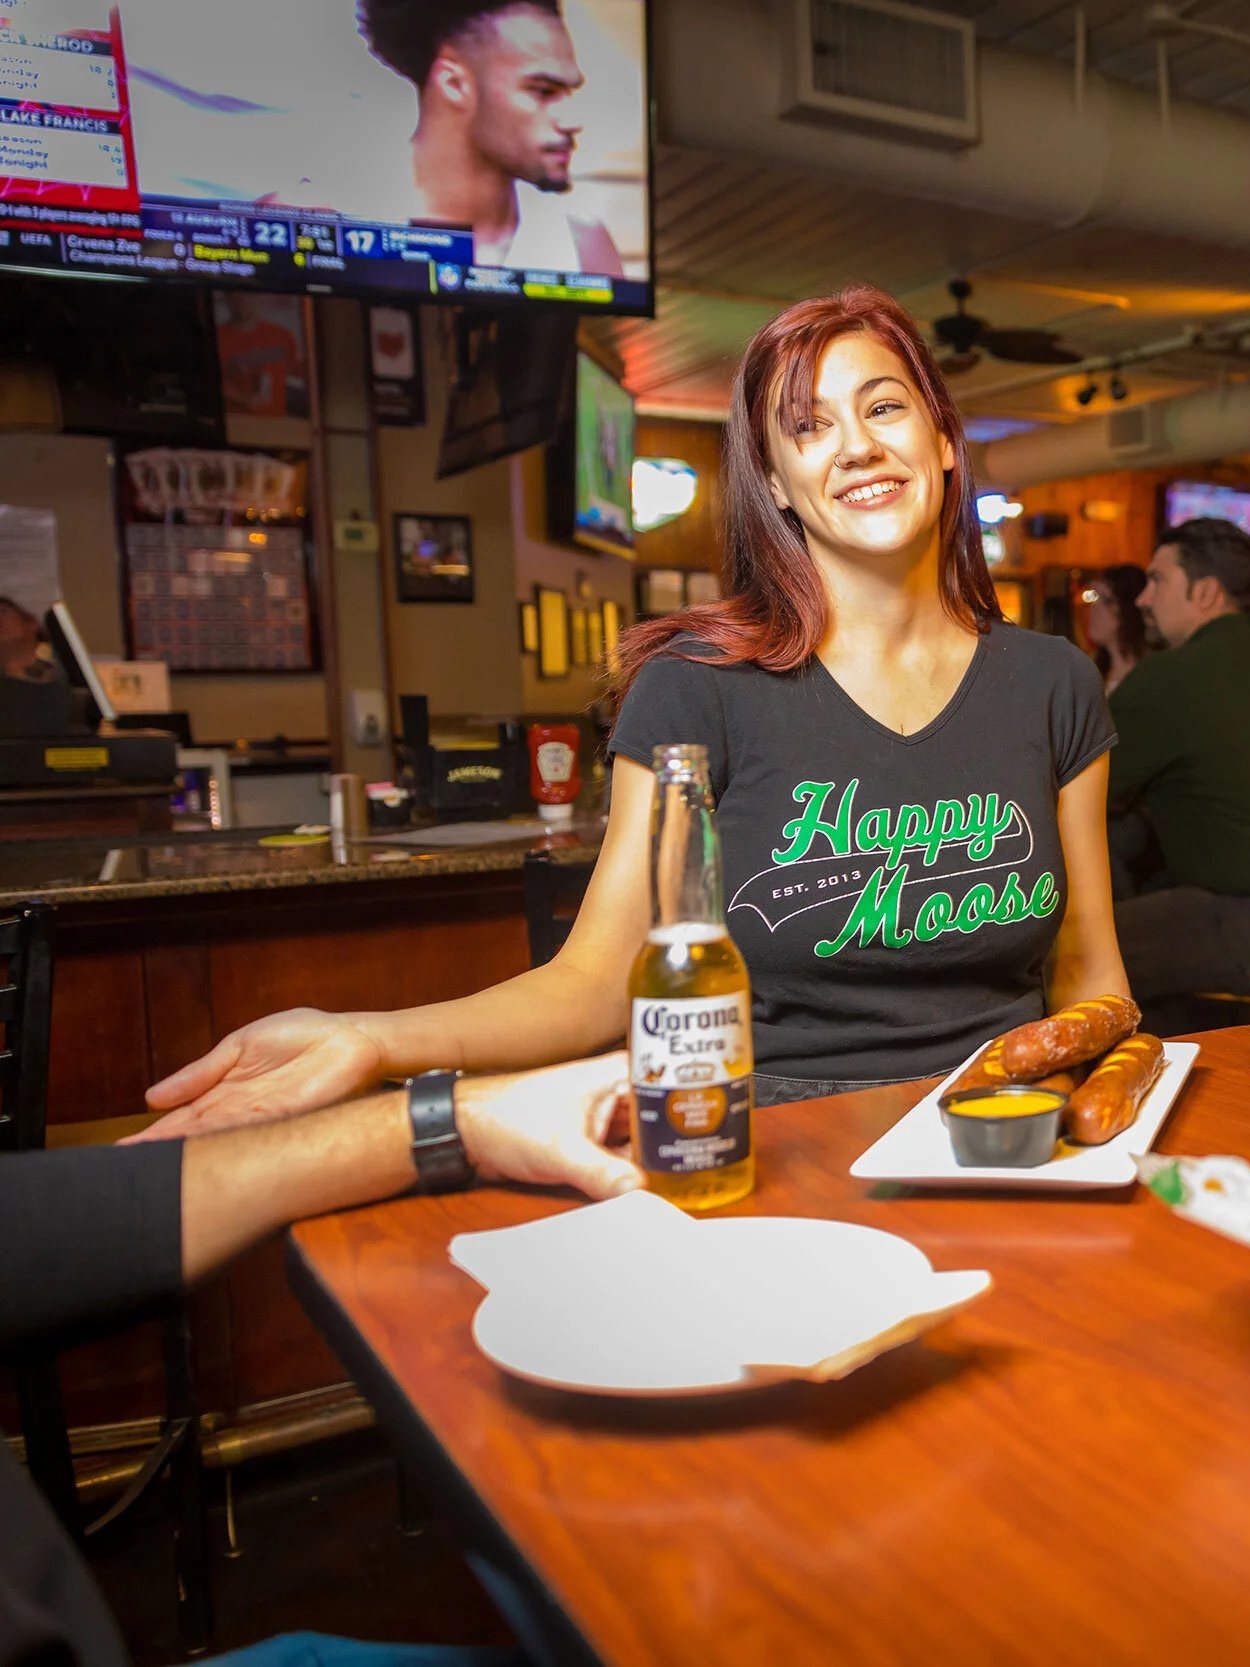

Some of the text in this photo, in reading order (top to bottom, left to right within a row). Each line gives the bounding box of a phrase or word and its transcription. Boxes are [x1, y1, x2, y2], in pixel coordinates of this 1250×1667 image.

[44, 113, 109, 132] FRANCIS
[20, 232, 53, 246] UEFA
[254, 221, 288, 247] 22
[344, 229, 376, 255] 17
[446, 765, 504, 783] JAMESON
[771, 778, 1012, 870] Happy
[772, 870, 862, 899] EST. 2013
[814, 863, 1059, 958] Moose
[640, 1004, 744, 1038] Corona
[669, 1034, 726, 1055] Extra
